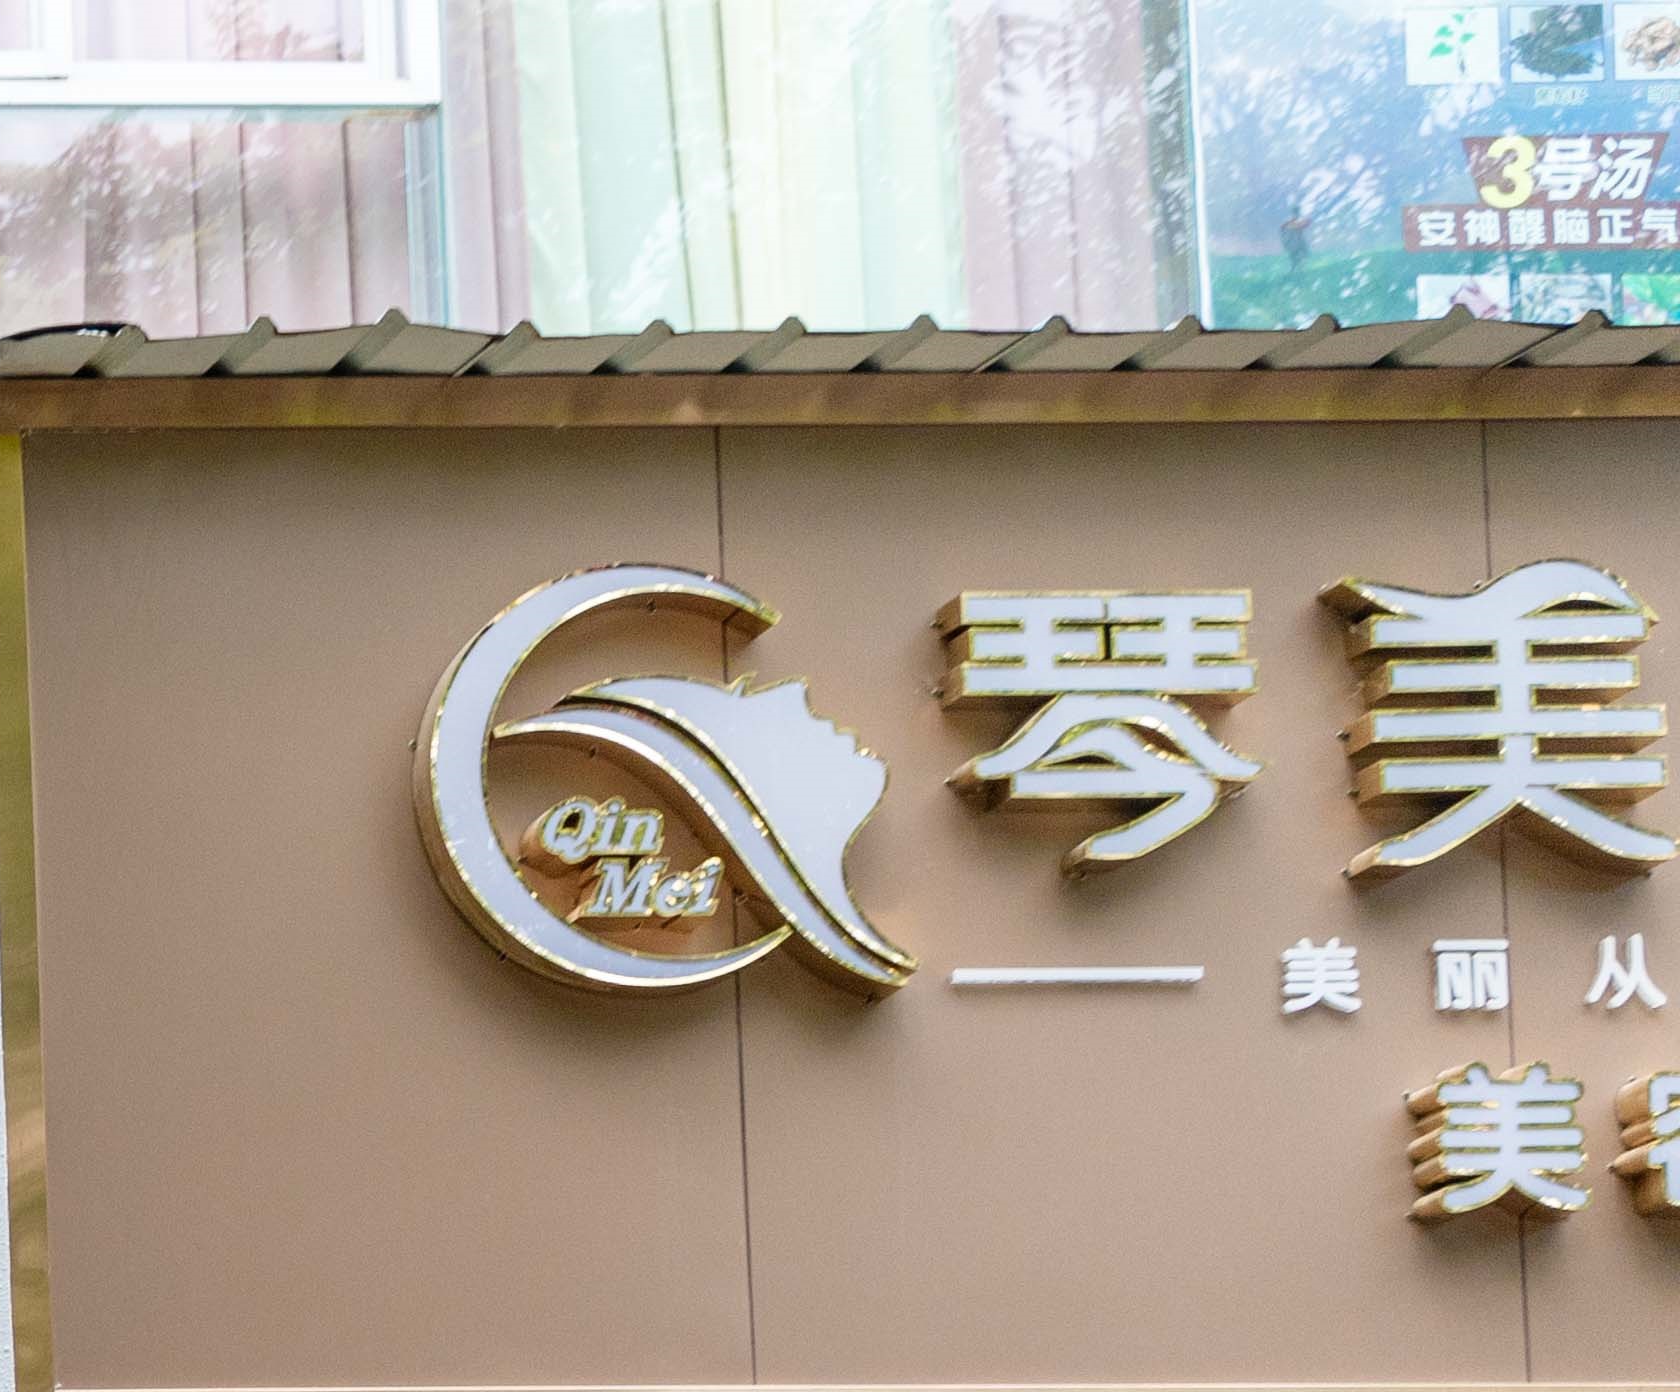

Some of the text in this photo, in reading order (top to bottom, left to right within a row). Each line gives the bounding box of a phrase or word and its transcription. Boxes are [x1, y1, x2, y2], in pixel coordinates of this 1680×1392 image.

[1480, 134, 1655, 209] 3号汤
[938, 589, 1680, 876] 琴美
[542, 796, 664, 864] Qin
[584, 856, 723, 917] Mei
[1281, 934, 1668, 1018] 美丽从
